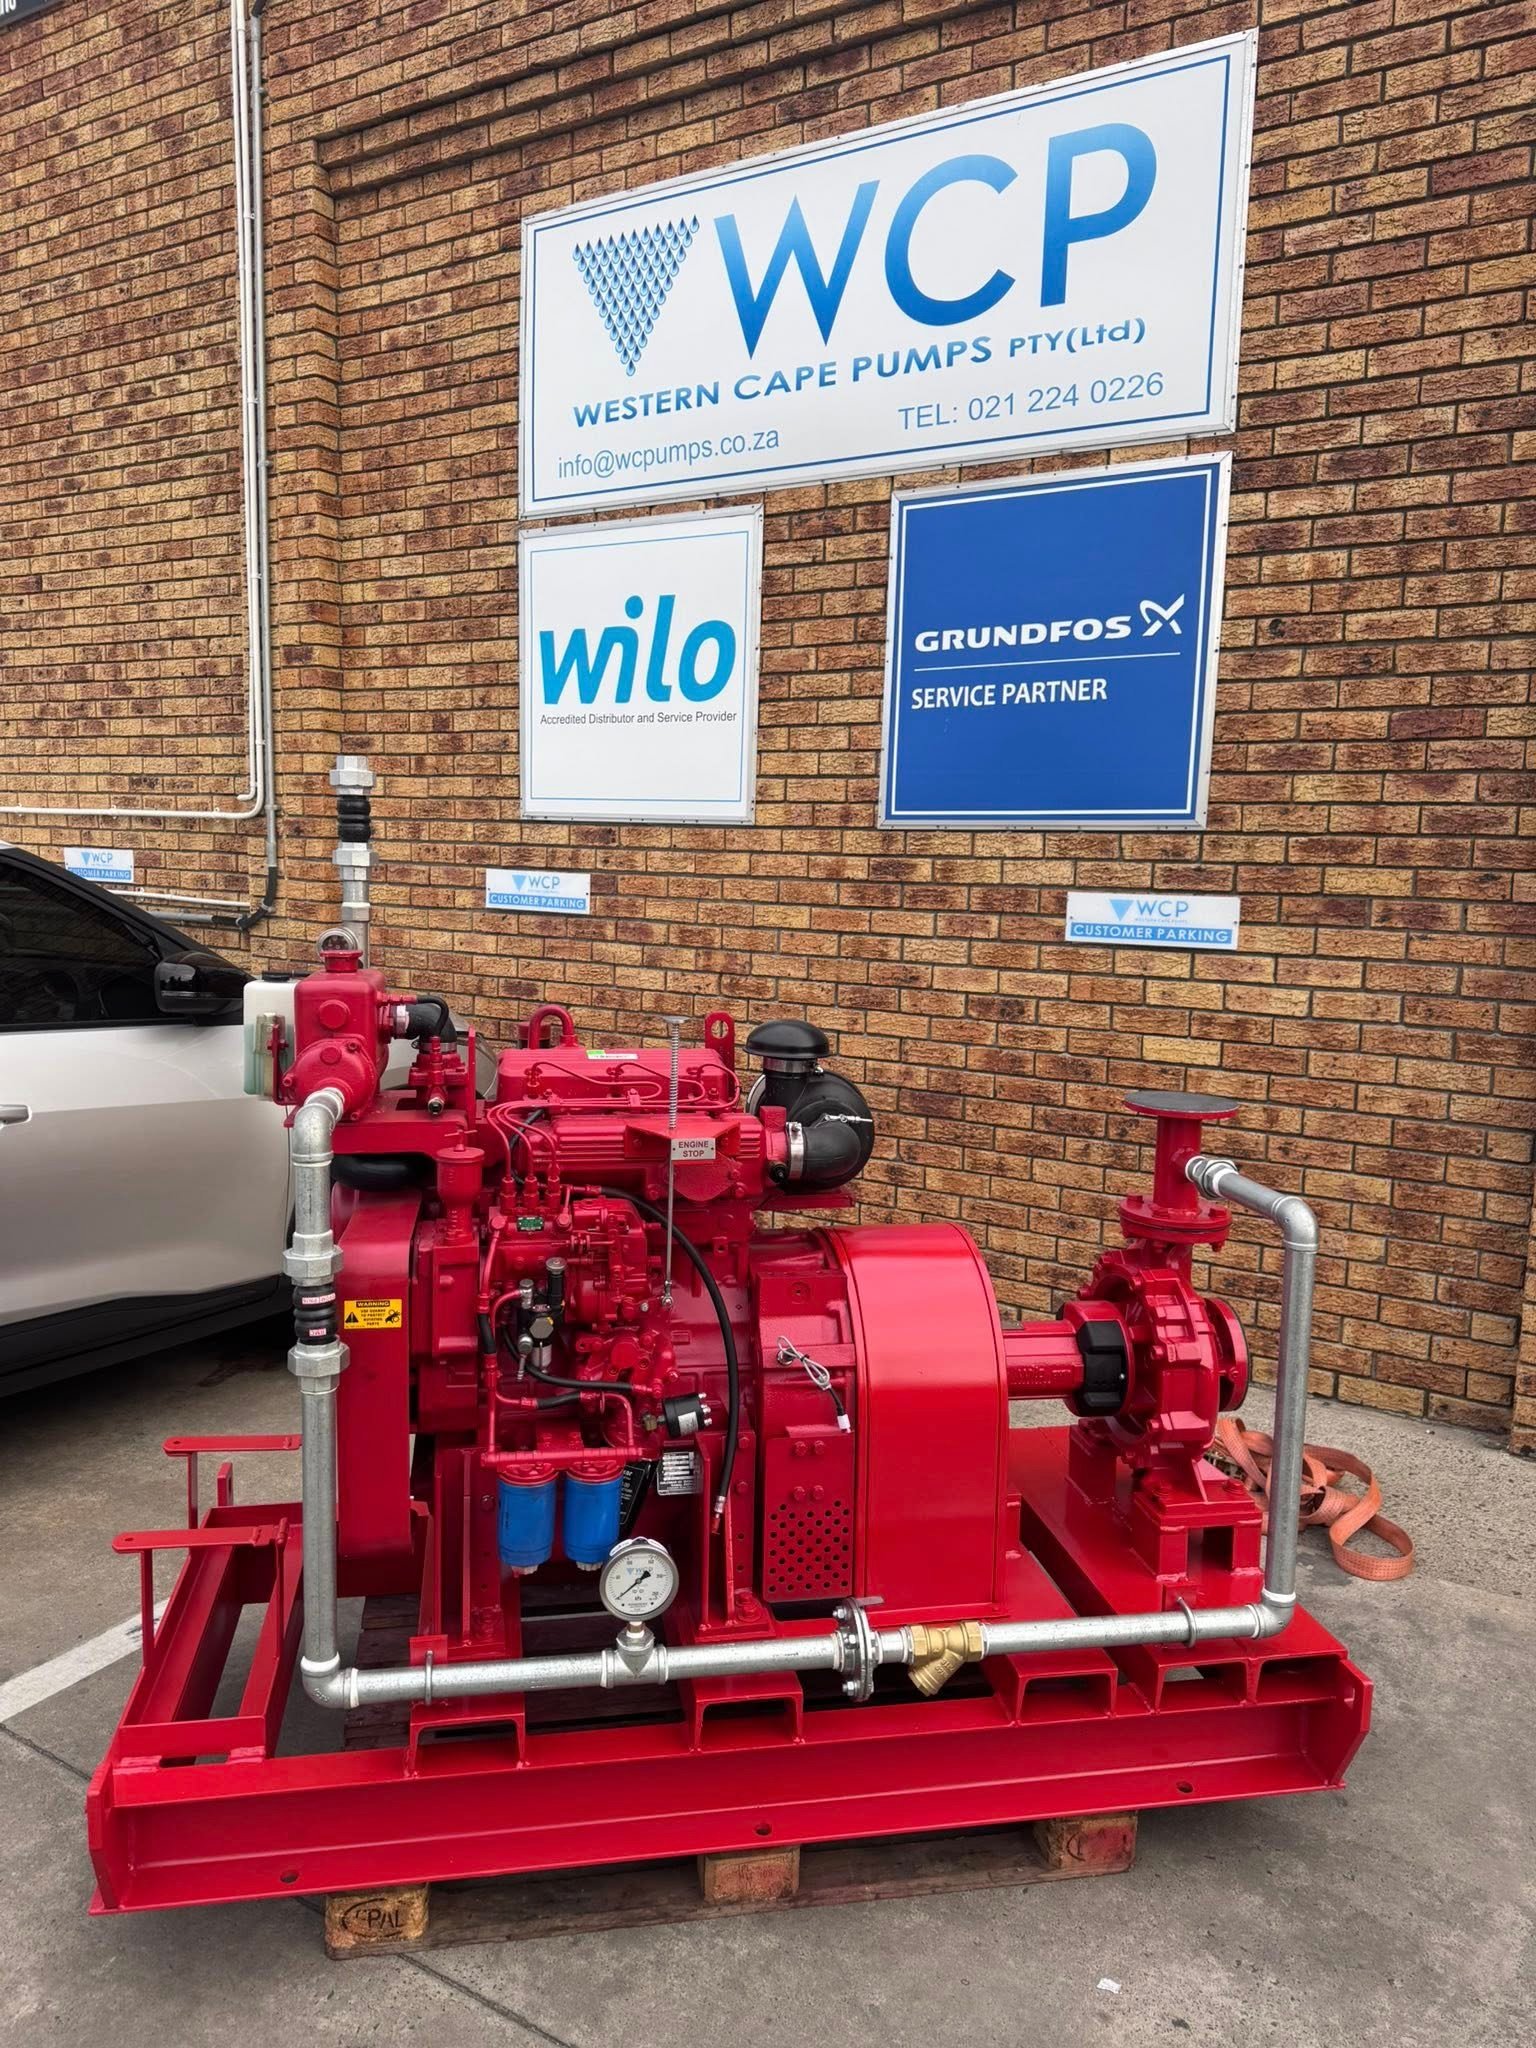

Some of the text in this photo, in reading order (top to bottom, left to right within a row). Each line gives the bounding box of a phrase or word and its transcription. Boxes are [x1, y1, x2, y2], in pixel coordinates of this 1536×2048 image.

[714, 123, 1157, 360] WCP
[573, 318, 1146, 428] WESTERN CAPE PUMPS PTY(Ltd)
[898, 372, 1164, 430] TEL: 021 224 0226
[558, 429, 779, 479] info@wcpumps.co.za
[914, 615, 1132, 653] GRUNDFOS
[539, 594, 737, 704] wilo
[911, 678, 1108, 710] SERVICE PARTNER
[540, 710, 737, 725] Accredited Distributor and Service Provider
[92, 852, 113, 864] WCP
[101, 870, 130, 879] PARKING
[528, 875, 560, 889] WCP
[490, 894, 585, 909] CUSTOMER PARKING
[1136, 899, 1189, 917] WCP
[1073, 924, 1229, 942] CUSTOMER PARKING
[678, 1140, 709, 1149] ENGINE
[682, 1149, 705, 1158] STOP
